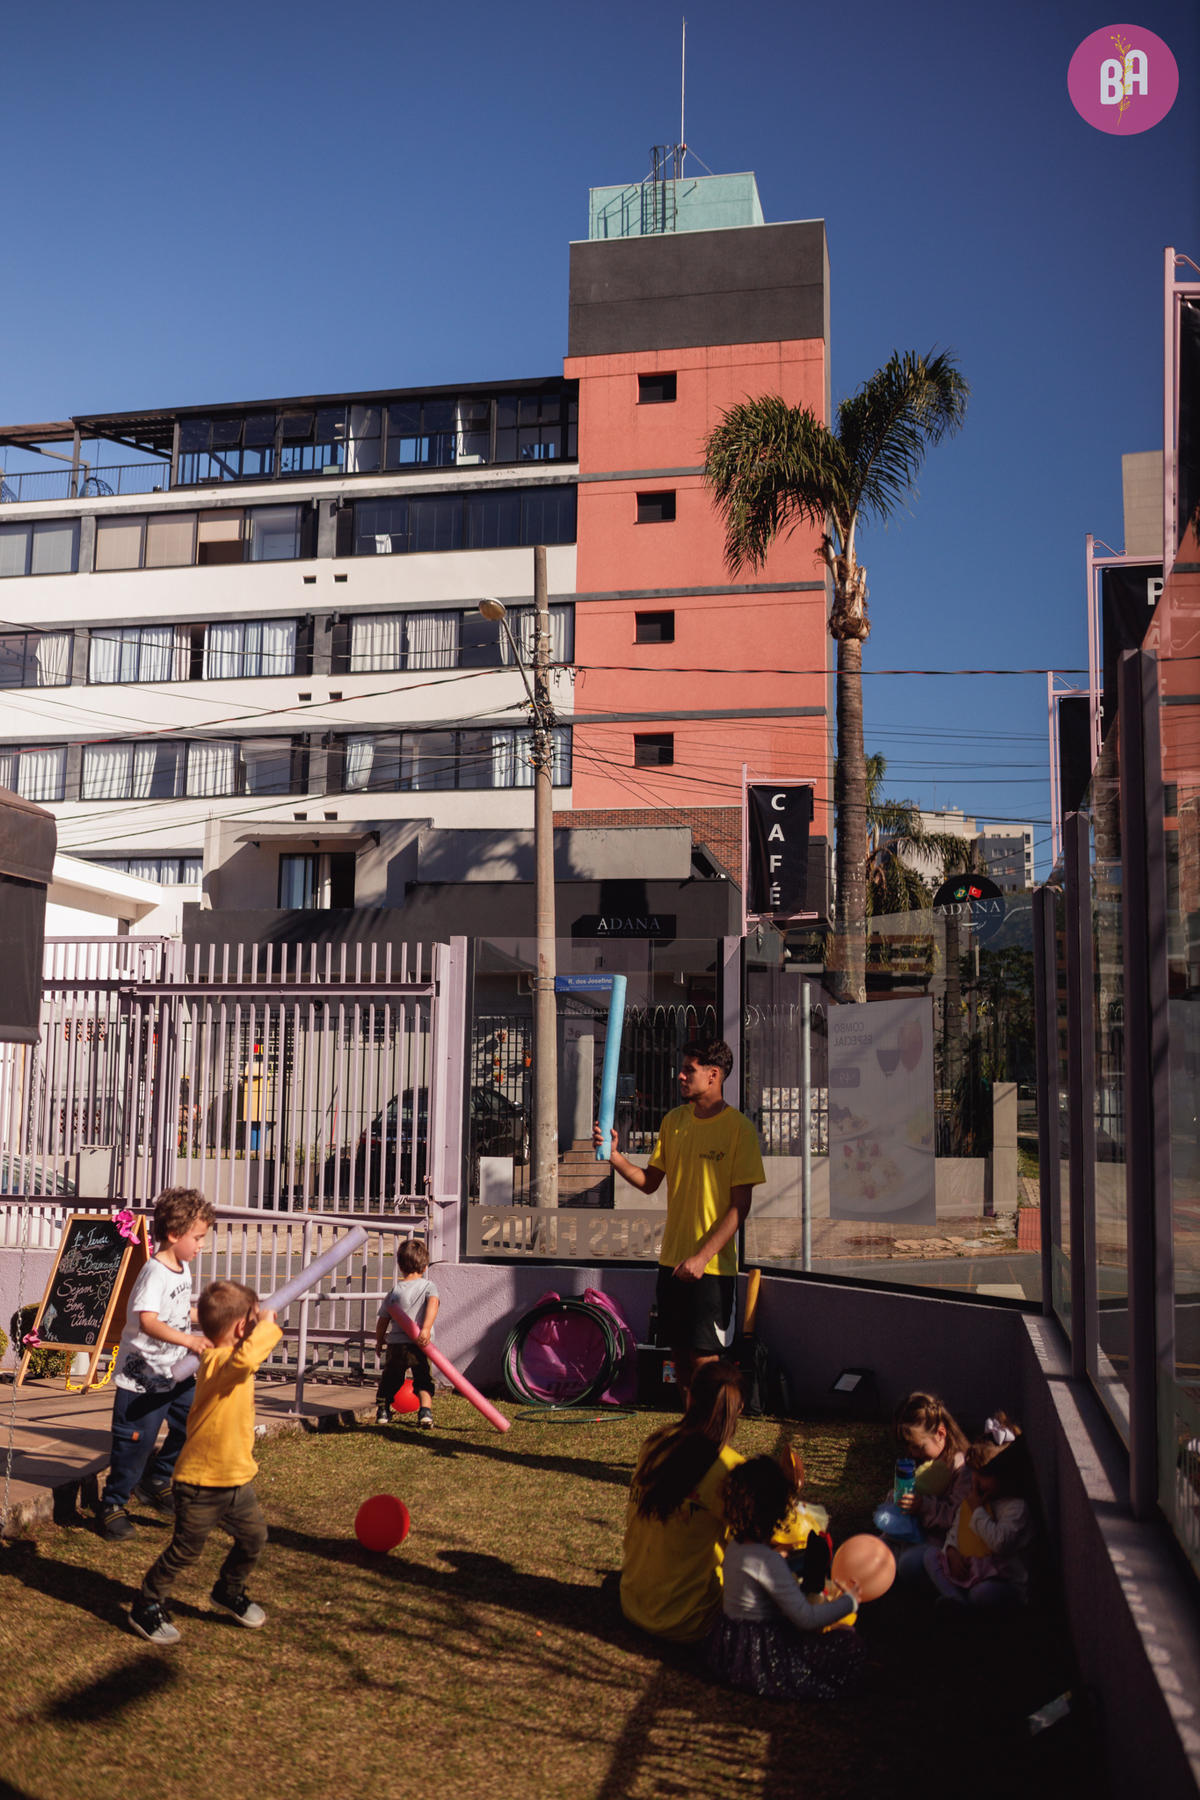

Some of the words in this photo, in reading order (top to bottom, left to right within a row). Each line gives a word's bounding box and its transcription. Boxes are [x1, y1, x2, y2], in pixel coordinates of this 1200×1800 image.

[767, 793, 787, 906] CAFÉ
[937, 900, 1001, 916] ADANA
[597, 917, 661, 930] ADANA
[587, 977, 613, 985] Josefino
[567, 1027, 582, 1039] 36
[56, 1278, 95, 1300] Sejam
